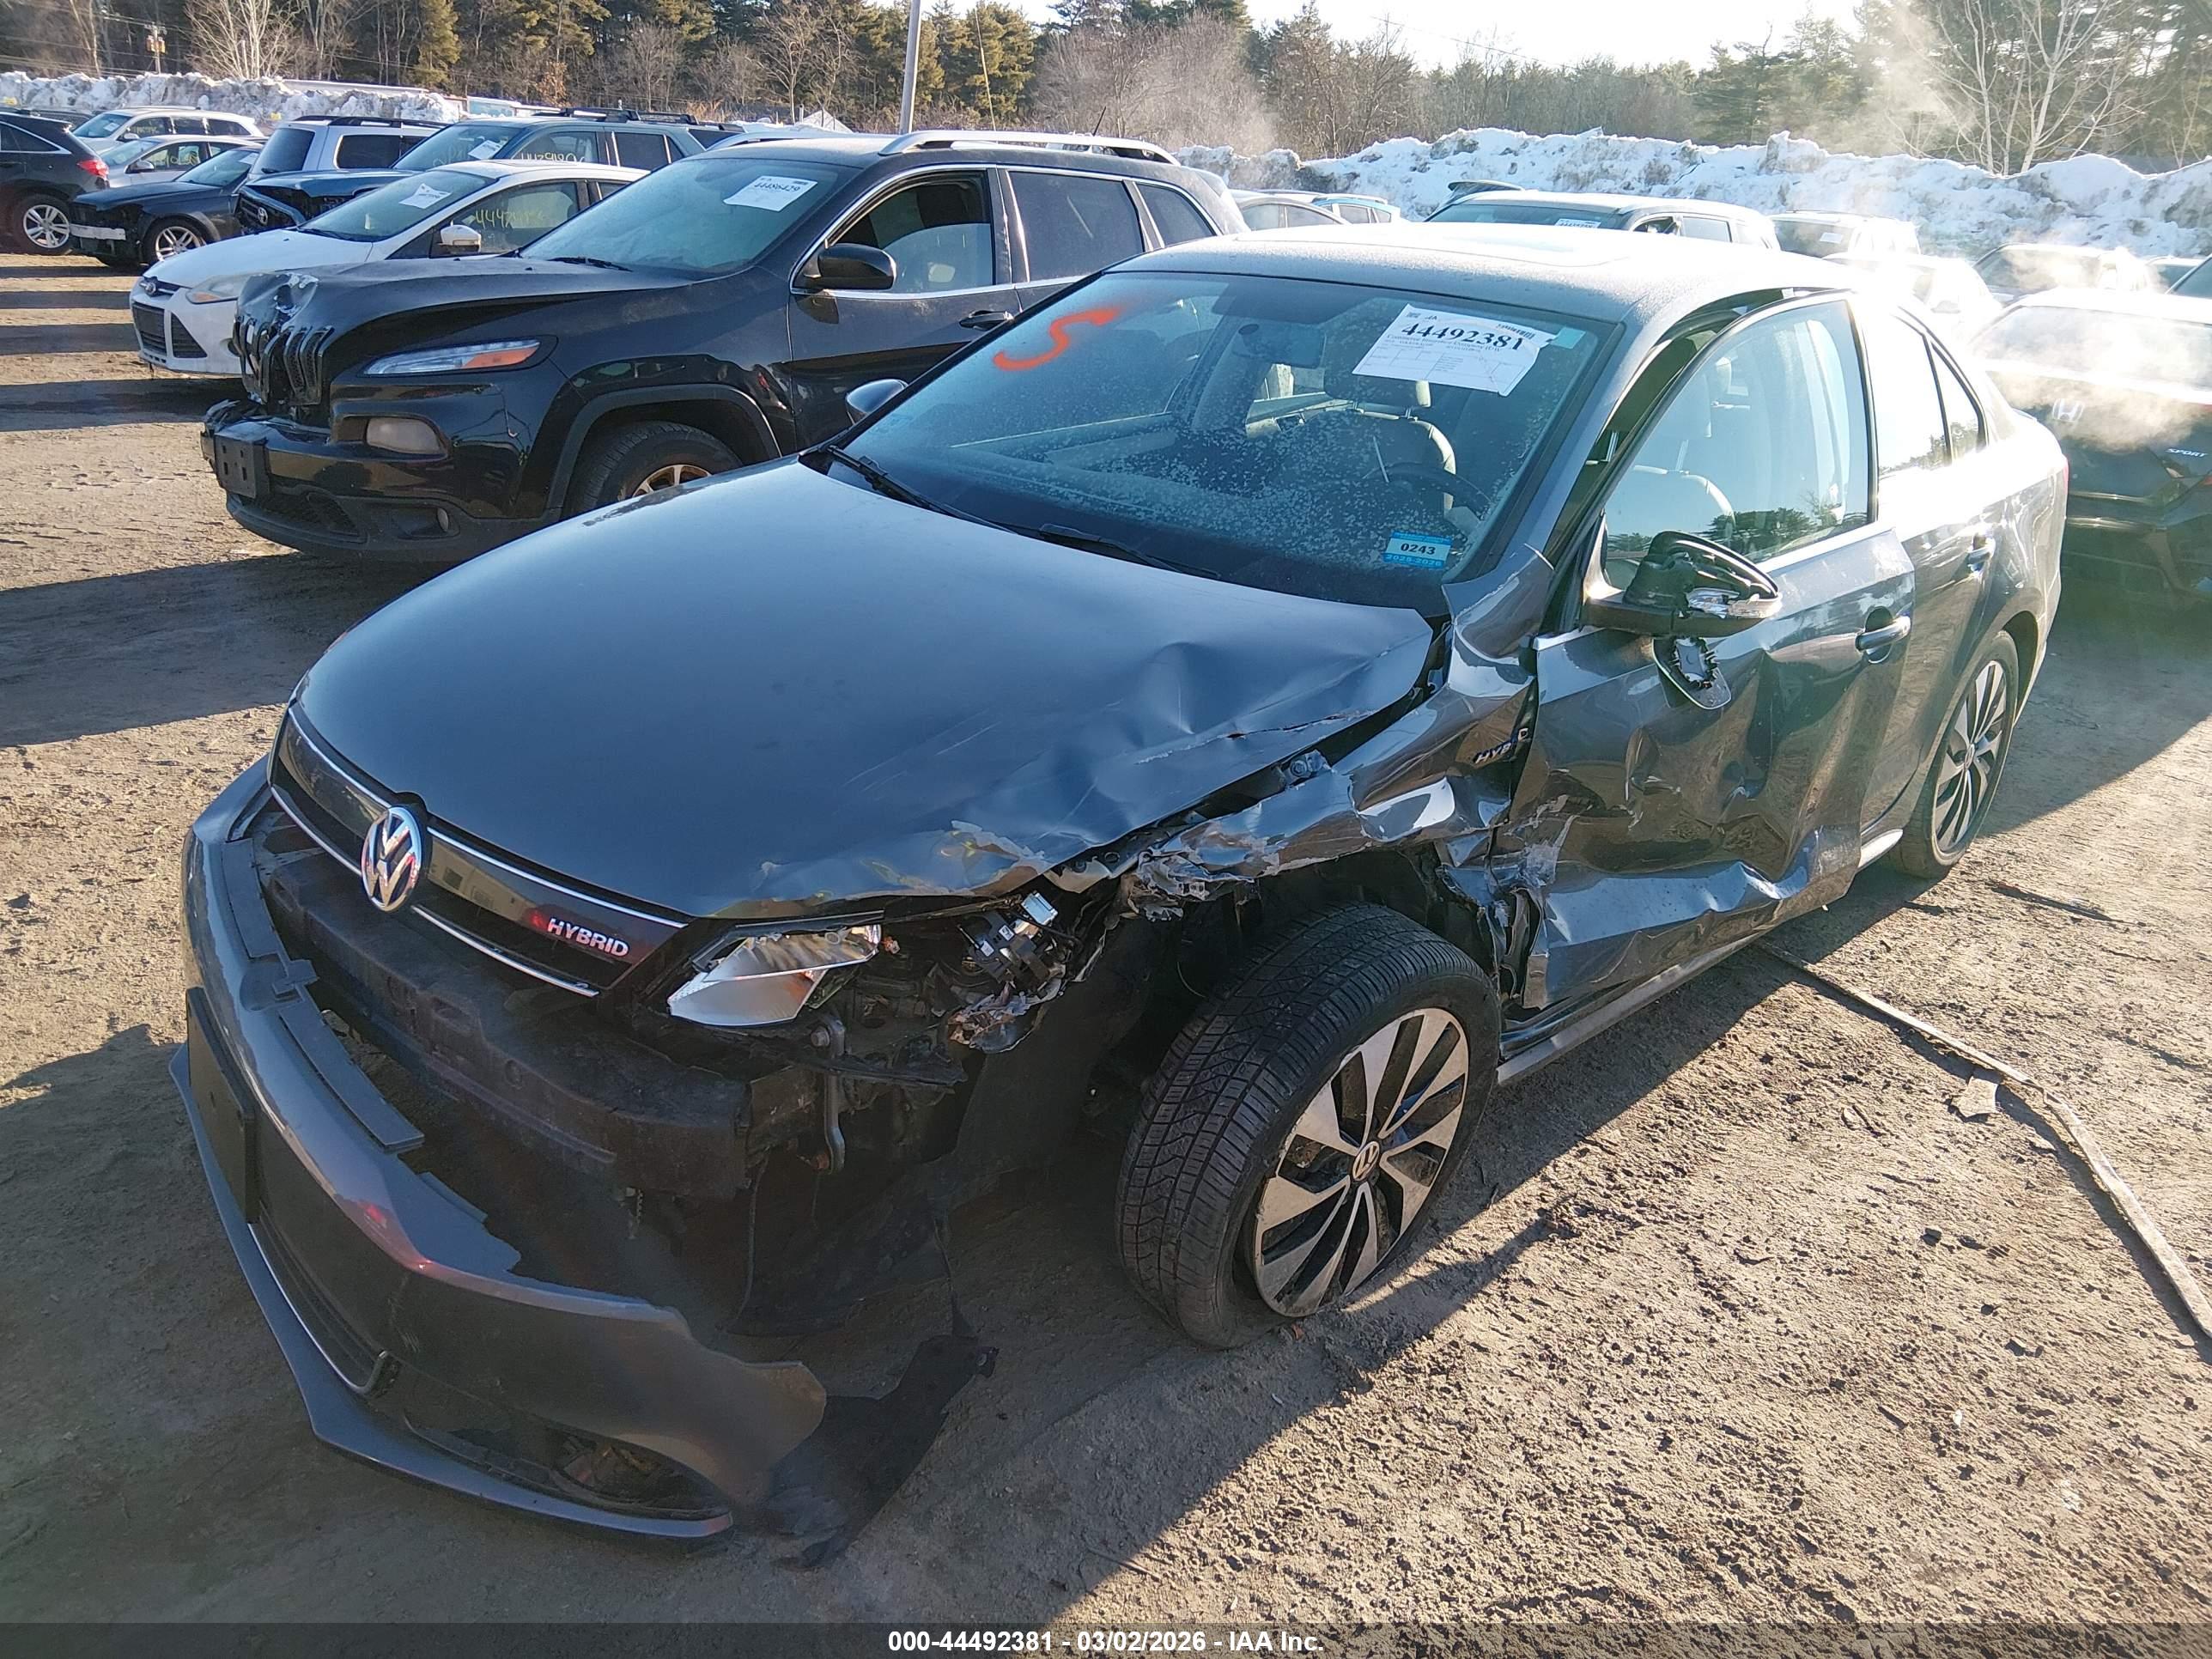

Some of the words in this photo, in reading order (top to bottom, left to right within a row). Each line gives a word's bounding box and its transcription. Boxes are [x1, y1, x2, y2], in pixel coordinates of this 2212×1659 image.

[1401, 322, 1525, 350] 44492381
[2166, 448, 2208, 458] SPORT
[1401, 543, 1436, 555] 0243
[547, 917, 631, 957] HYBRID
